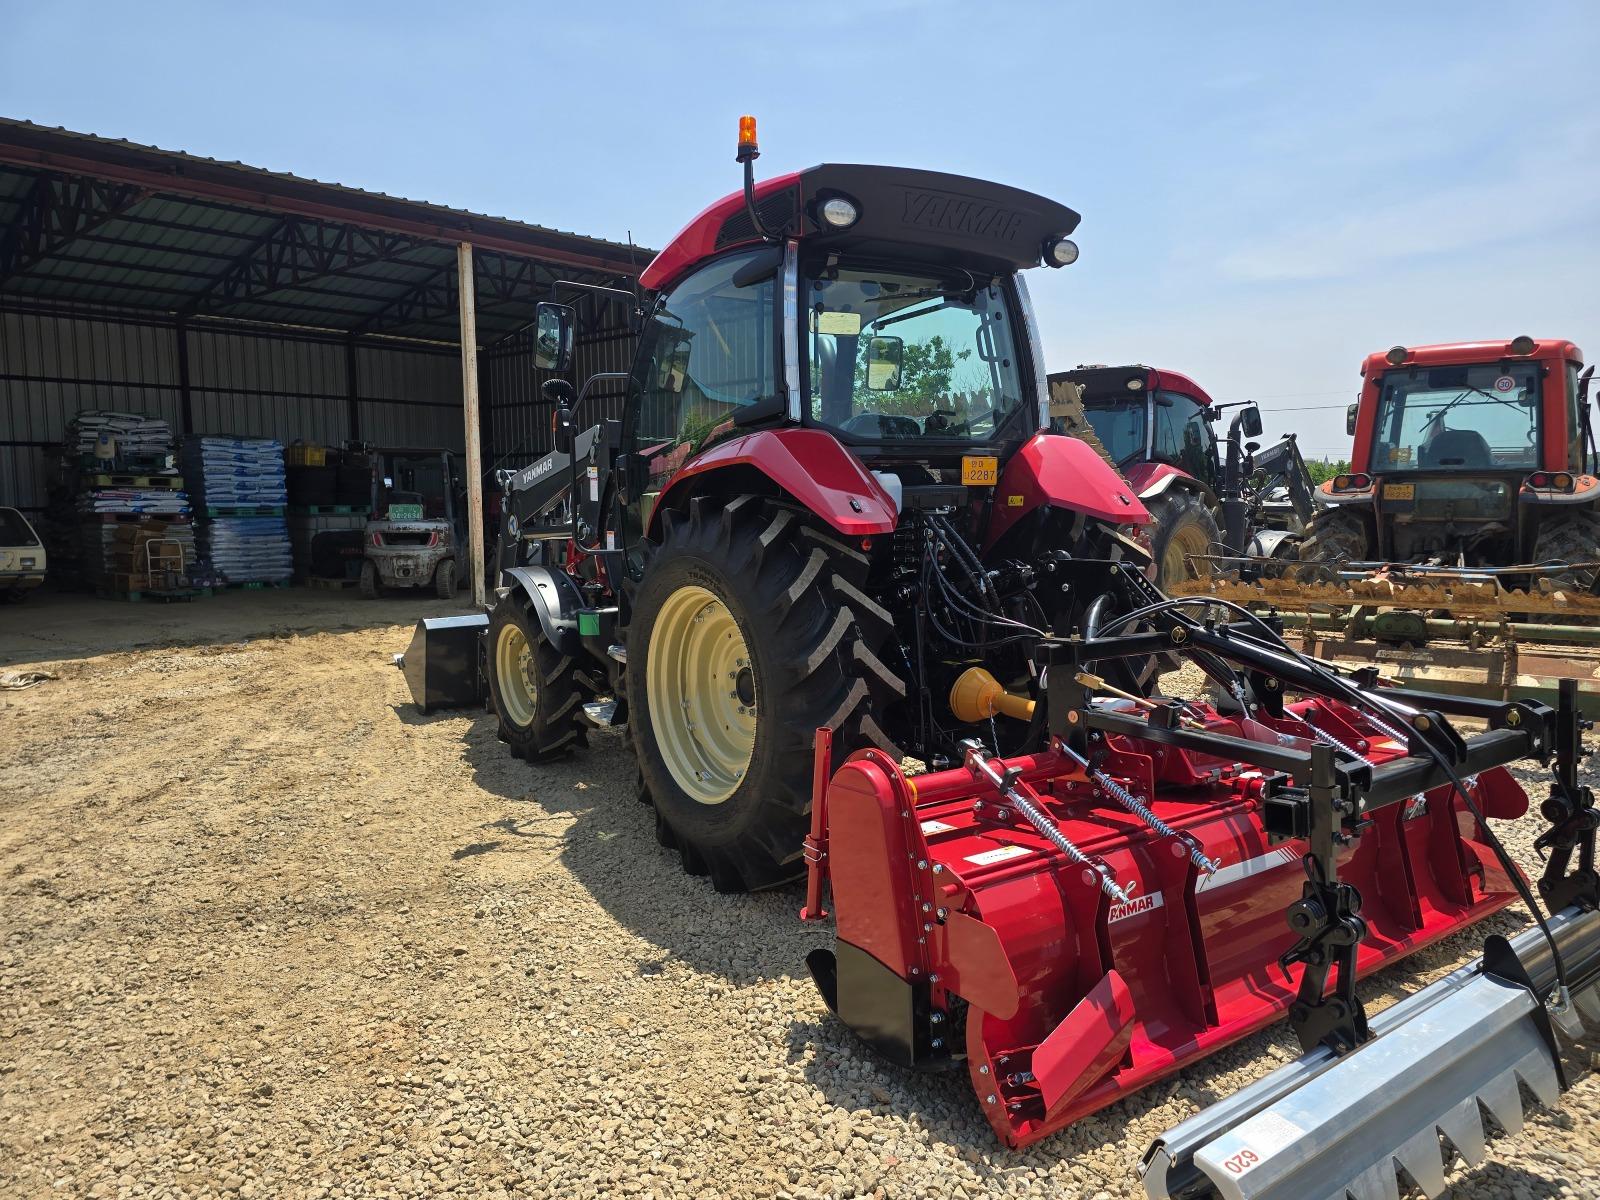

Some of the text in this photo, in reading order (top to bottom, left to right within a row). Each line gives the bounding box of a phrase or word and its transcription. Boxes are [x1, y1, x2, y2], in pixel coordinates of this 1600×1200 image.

[902, 191, 1026, 241] YANMAR
[522, 458, 553, 484] YANMAR
[1110, 896, 1153, 921] ANMAR
[1224, 1149, 1259, 1174] 620
